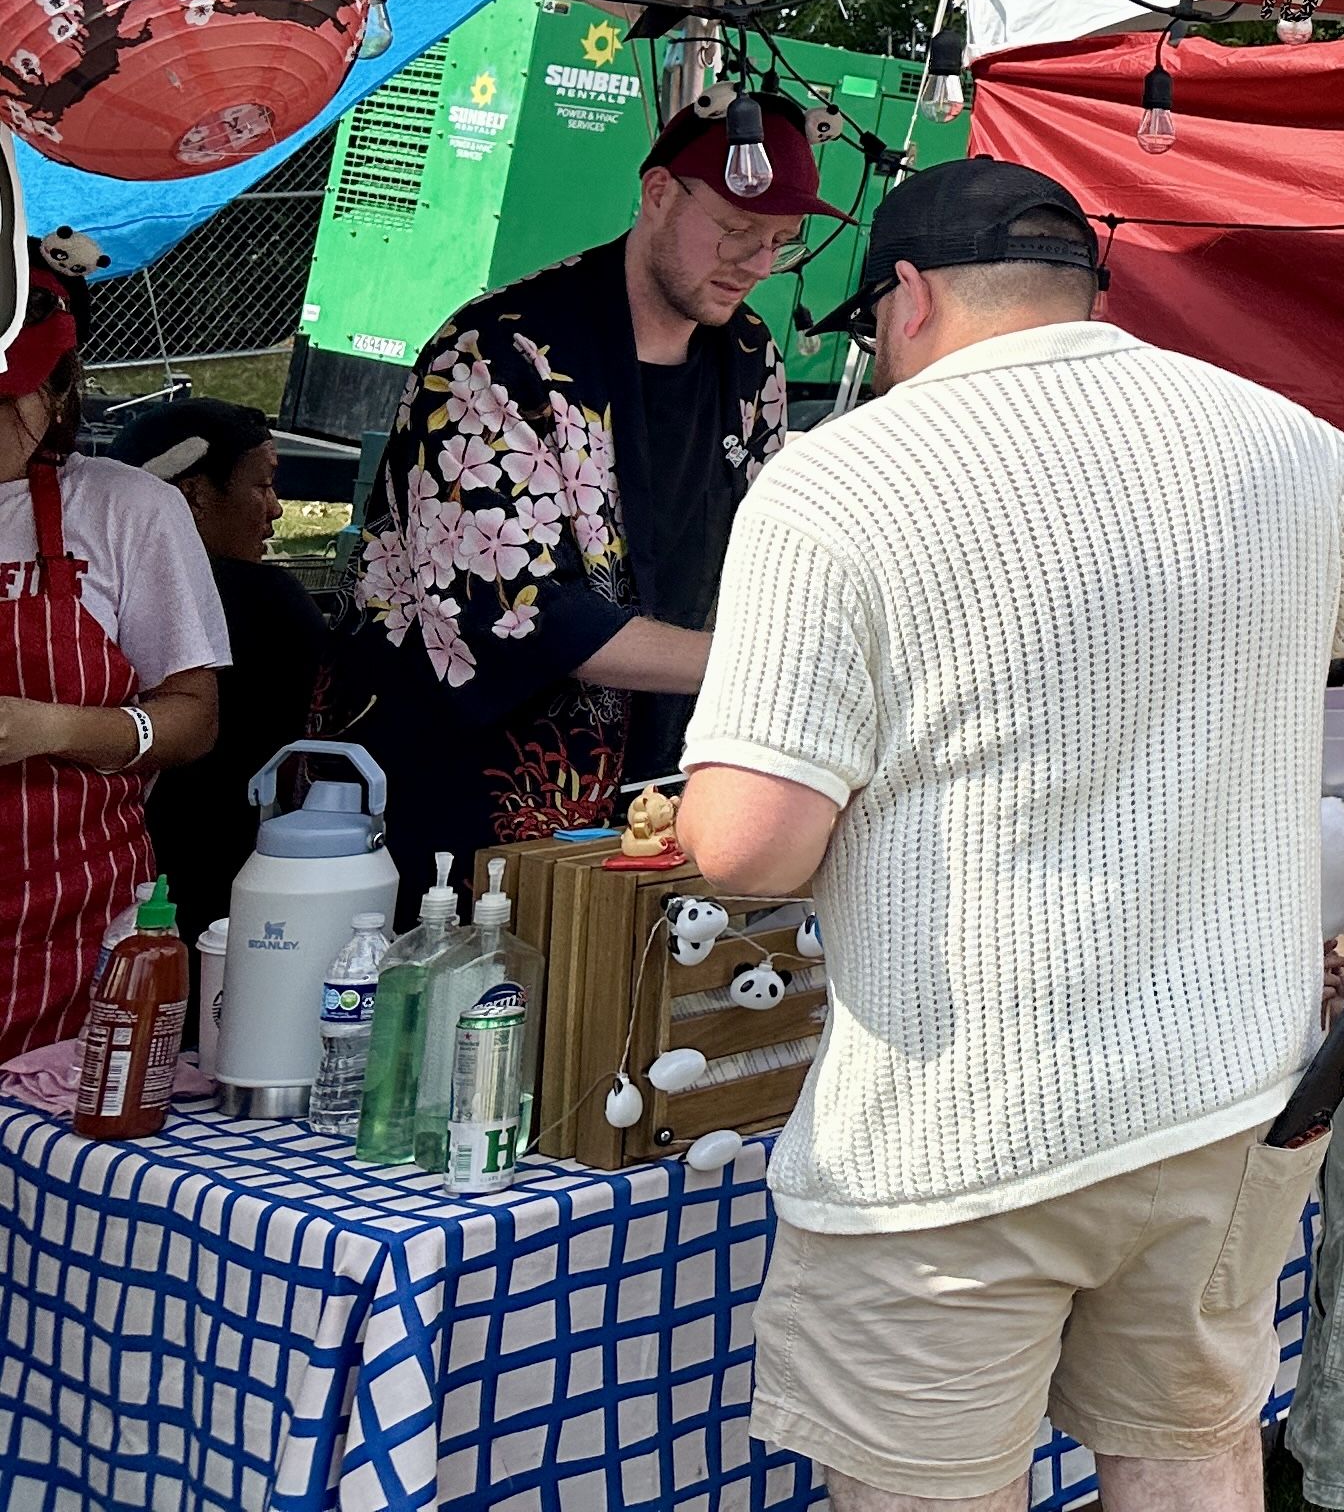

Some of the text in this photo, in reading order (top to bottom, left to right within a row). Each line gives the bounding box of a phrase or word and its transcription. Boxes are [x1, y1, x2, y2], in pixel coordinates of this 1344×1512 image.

[556, 87, 626, 105] RENTALS
[448, 105, 508, 131] SUNBELT
[556, 107, 619, 124] POWER & HVAC
[454, 122, 497, 136] RENTALS
[567, 118, 606, 133] SERVICES
[248, 939, 299, 950] STANLEY
